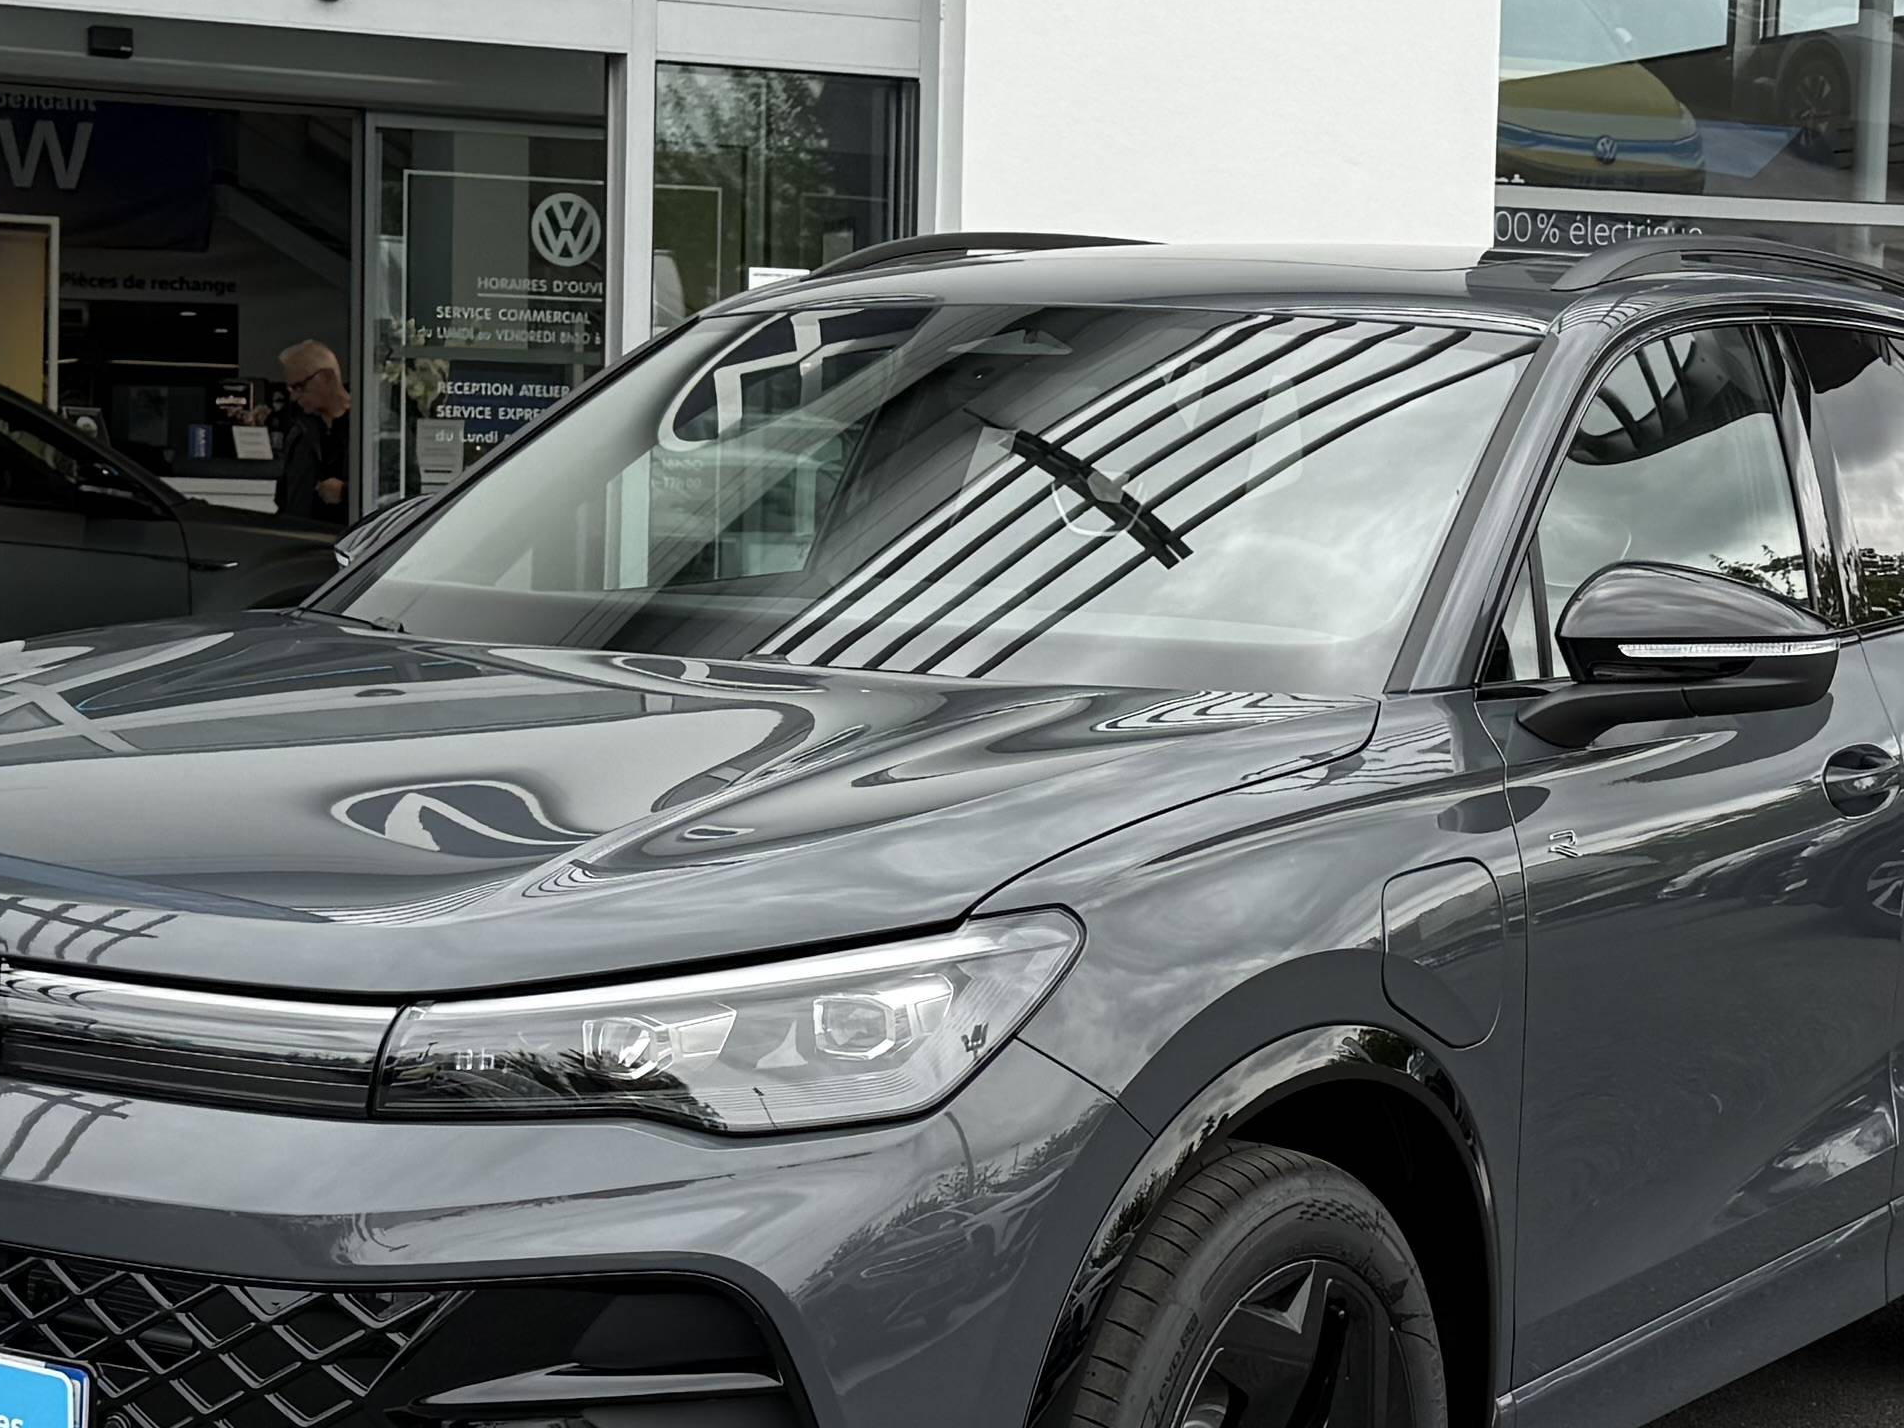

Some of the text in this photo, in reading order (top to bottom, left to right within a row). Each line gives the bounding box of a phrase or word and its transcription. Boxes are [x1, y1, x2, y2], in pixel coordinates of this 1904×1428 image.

[1537, 213, 1560, 244] %
[123, 274, 145, 290] de
[151, 276, 237, 297] rechange
[477, 276, 547, 293] HORAIRES
[436, 305, 592, 325] SERVICE COMMERCIAL
[496, 328, 556, 344] VENDREDI
[437, 380, 571, 399] RECEPTION ATELIER
[436, 404, 492, 420] SERVICE
